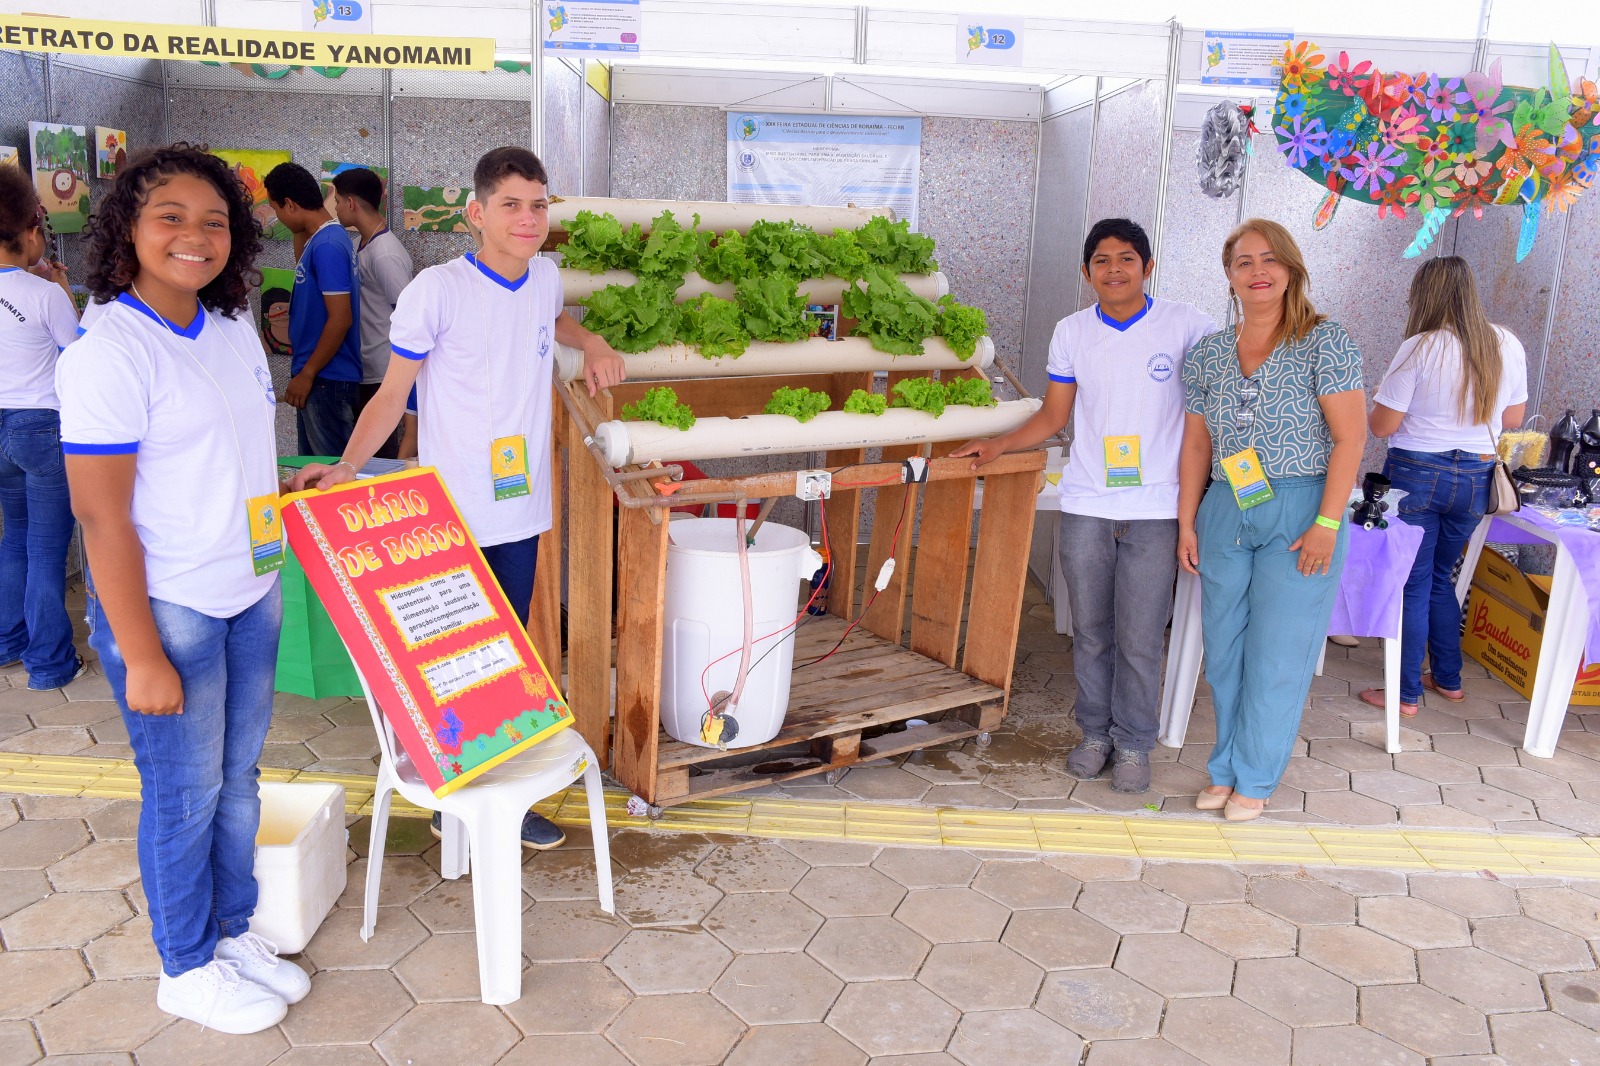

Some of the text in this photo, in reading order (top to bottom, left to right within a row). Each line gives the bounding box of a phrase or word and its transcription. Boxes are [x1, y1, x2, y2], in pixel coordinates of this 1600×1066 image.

[338, 6, 351, 16] 13
[0, 26, 471, 65] ETRATO DA REALIDADE YANOMAMI
[992, 35, 1005, 44] 12
[337, 486, 429, 532] DIÁRIO
[337, 521, 465, 577] DE BORDO
[390, 572, 466, 600] Hidroponia como meio
[397, 582, 471, 611] sustentável para uma
[402, 604, 439, 621] alimentação
[444, 594, 468, 606] saudável
[423, 627, 440, 639] renda
[1472, 599, 1531, 661] Bauducco
[1481, 651, 1504, 672] chamado
[1487, 643, 1527, 677] Um sentimento
